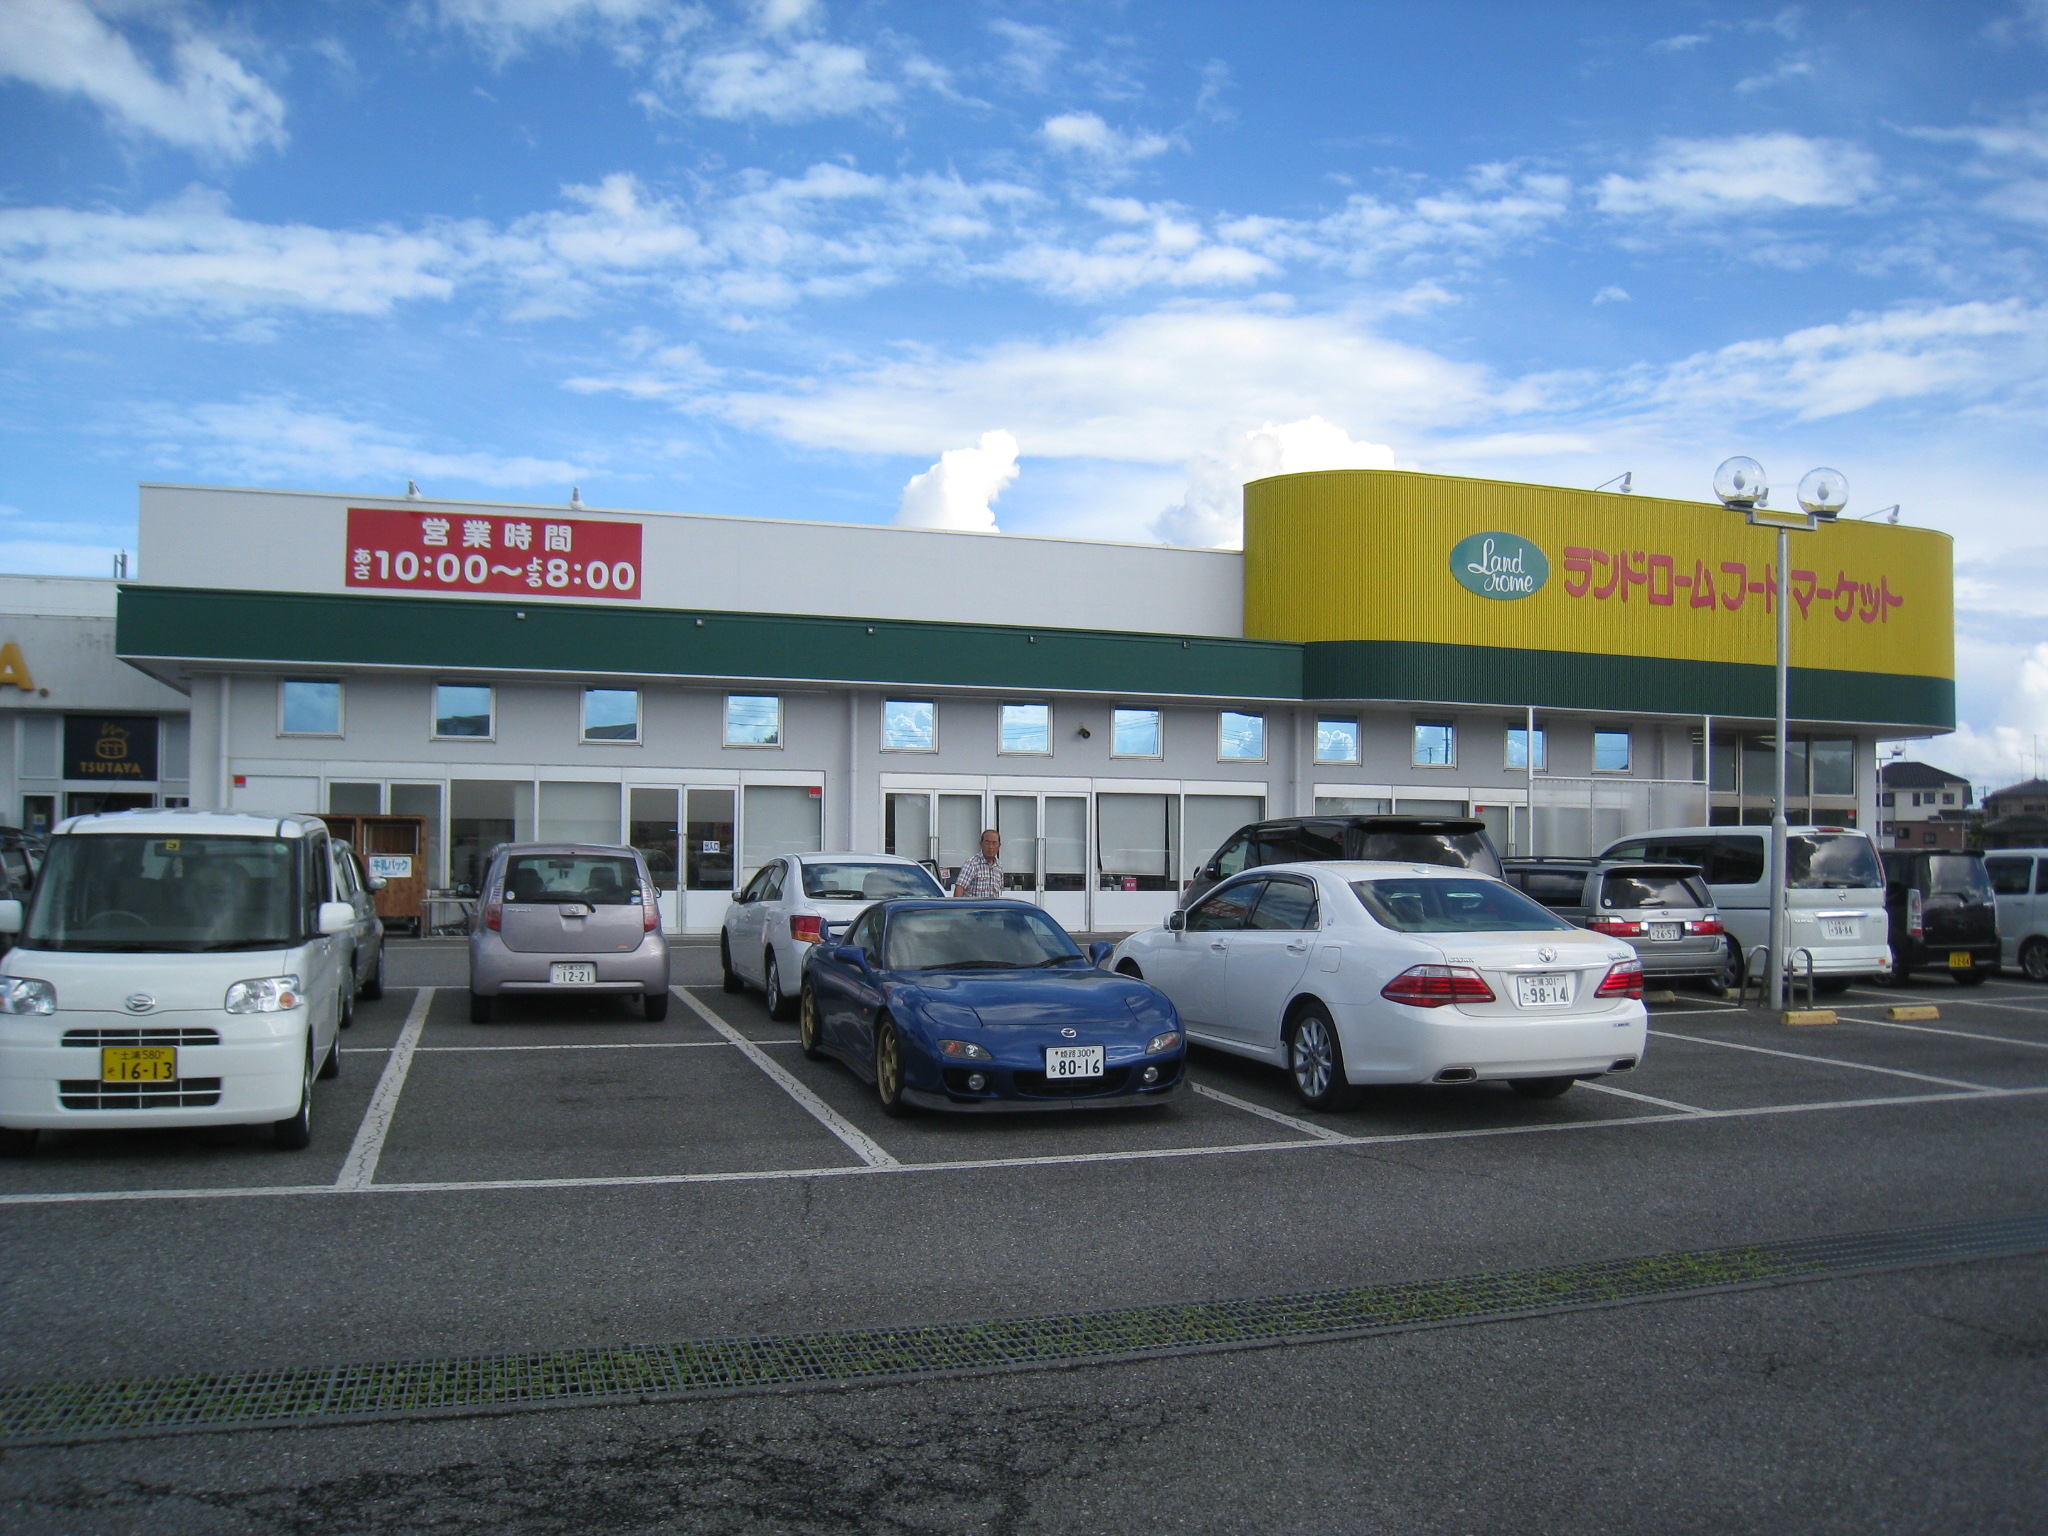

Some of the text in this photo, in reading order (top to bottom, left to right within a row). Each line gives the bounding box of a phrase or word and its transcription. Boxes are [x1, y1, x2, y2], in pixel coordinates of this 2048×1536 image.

[422, 517, 572, 552] 営業時間
[1467, 538, 1525, 575] Land
[79, 761, 142, 774] TSUTAYA
[373, 858, 409, 871] 牛乳パック
[563, 971, 591, 982] 12-21
[1530, 987, 1566, 1003] 98-14
[121, 1062, 173, 1080] 16-13
[1059, 1059, 1101, 1076] 80-16
